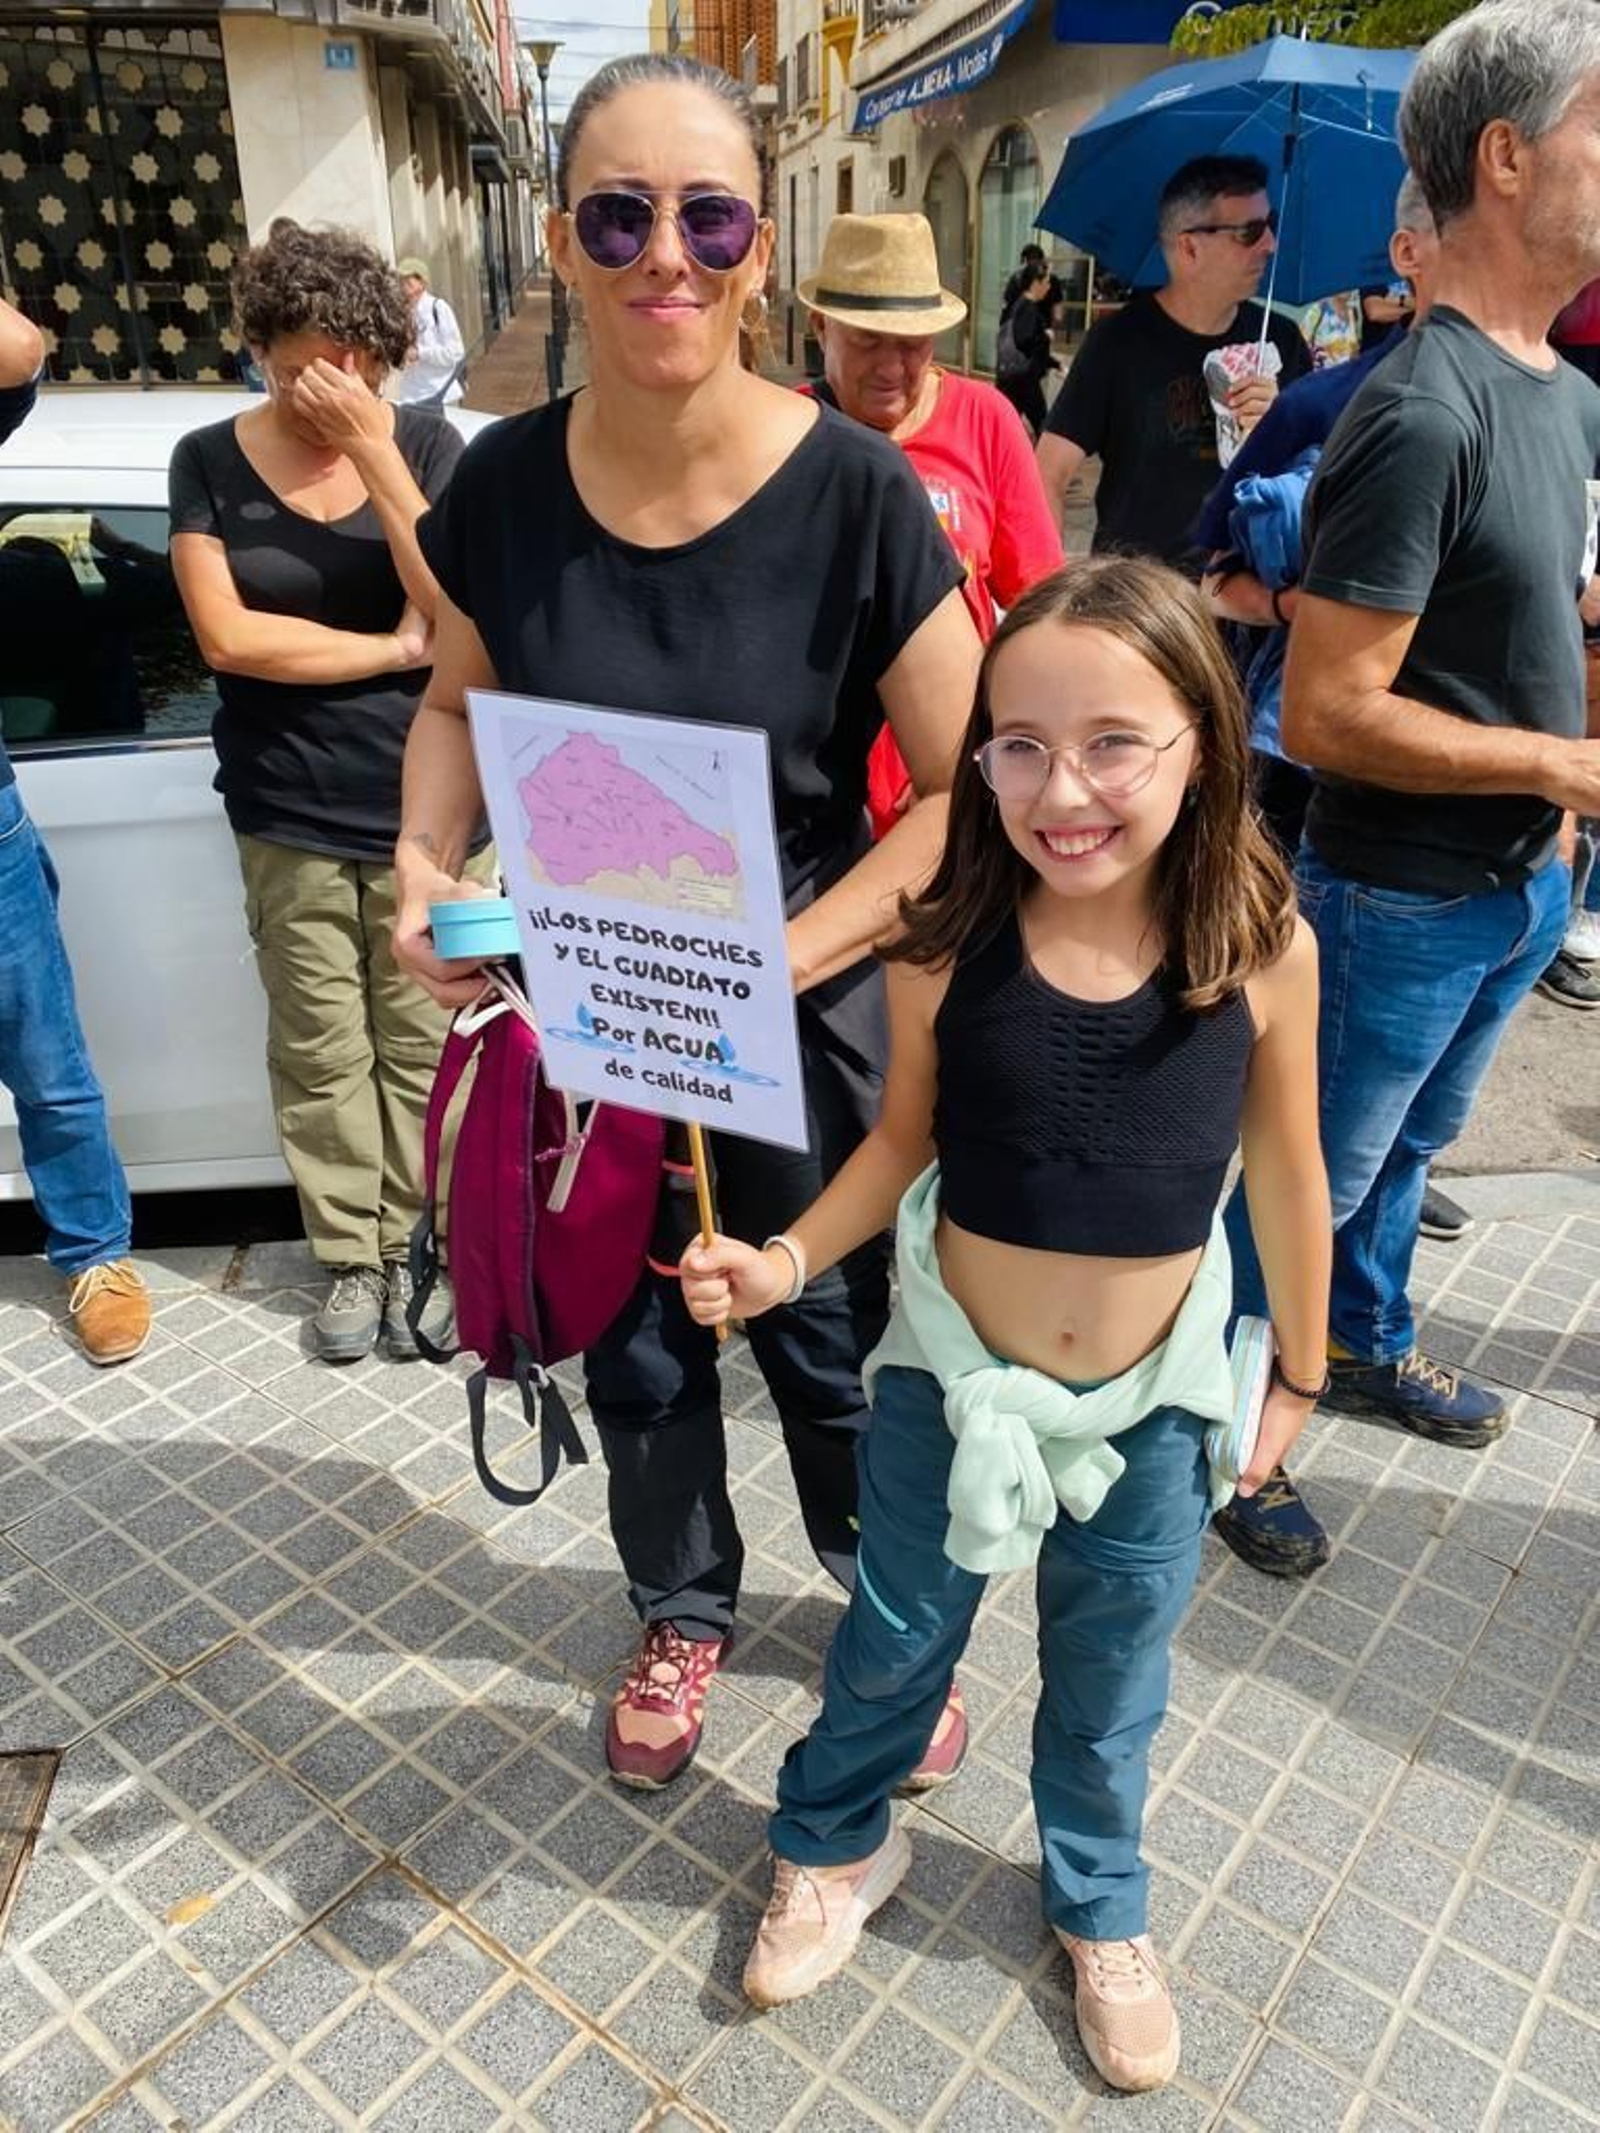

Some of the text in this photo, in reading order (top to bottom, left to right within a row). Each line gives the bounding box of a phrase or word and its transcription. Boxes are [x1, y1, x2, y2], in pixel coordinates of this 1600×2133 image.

[528, 907, 763, 968] ¡¡LOS PEDROCHES
[576, 946, 608, 970] EL
[613, 954, 751, 1000] GUADIATO
[590, 982, 722, 1029] EXISTEN!!
[591, 1016, 726, 1065] Por AGUA
[604, 1057, 734, 1104] de calidad
